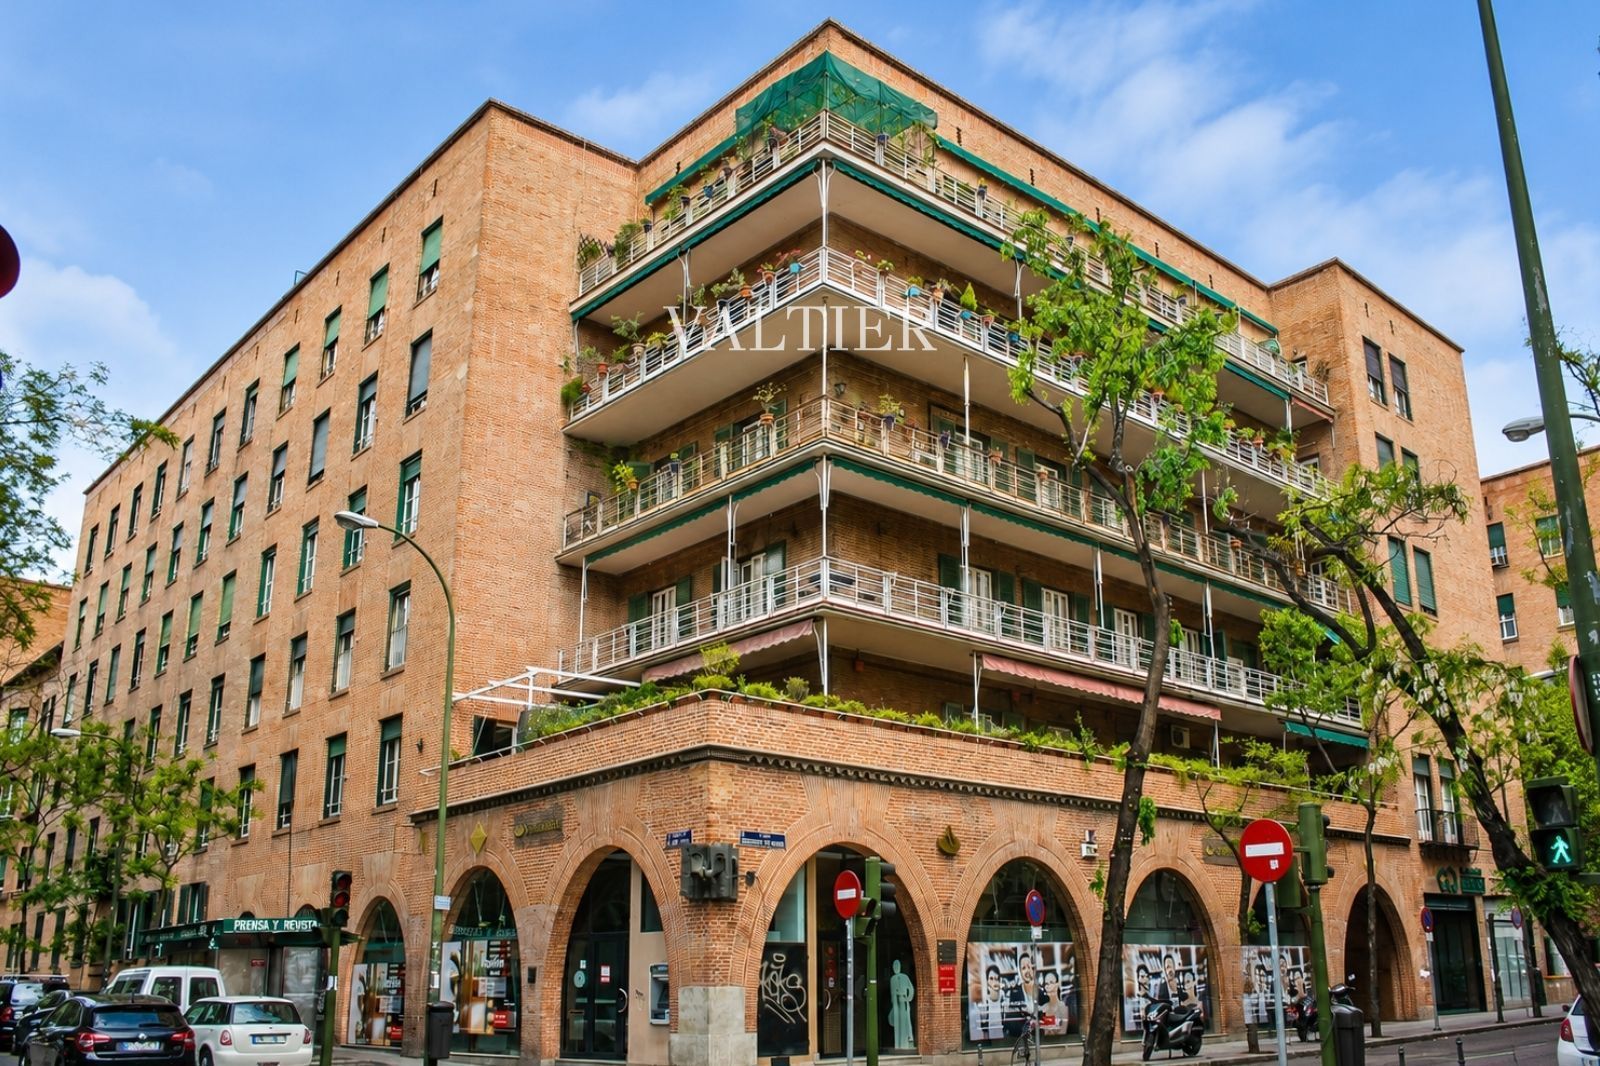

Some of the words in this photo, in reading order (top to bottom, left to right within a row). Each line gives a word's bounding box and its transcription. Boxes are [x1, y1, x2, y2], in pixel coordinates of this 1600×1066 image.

[233, 919, 270, 931] PRENSA
[272, 919, 280, 931] Y
[283, 919, 321, 931] REVISTA
